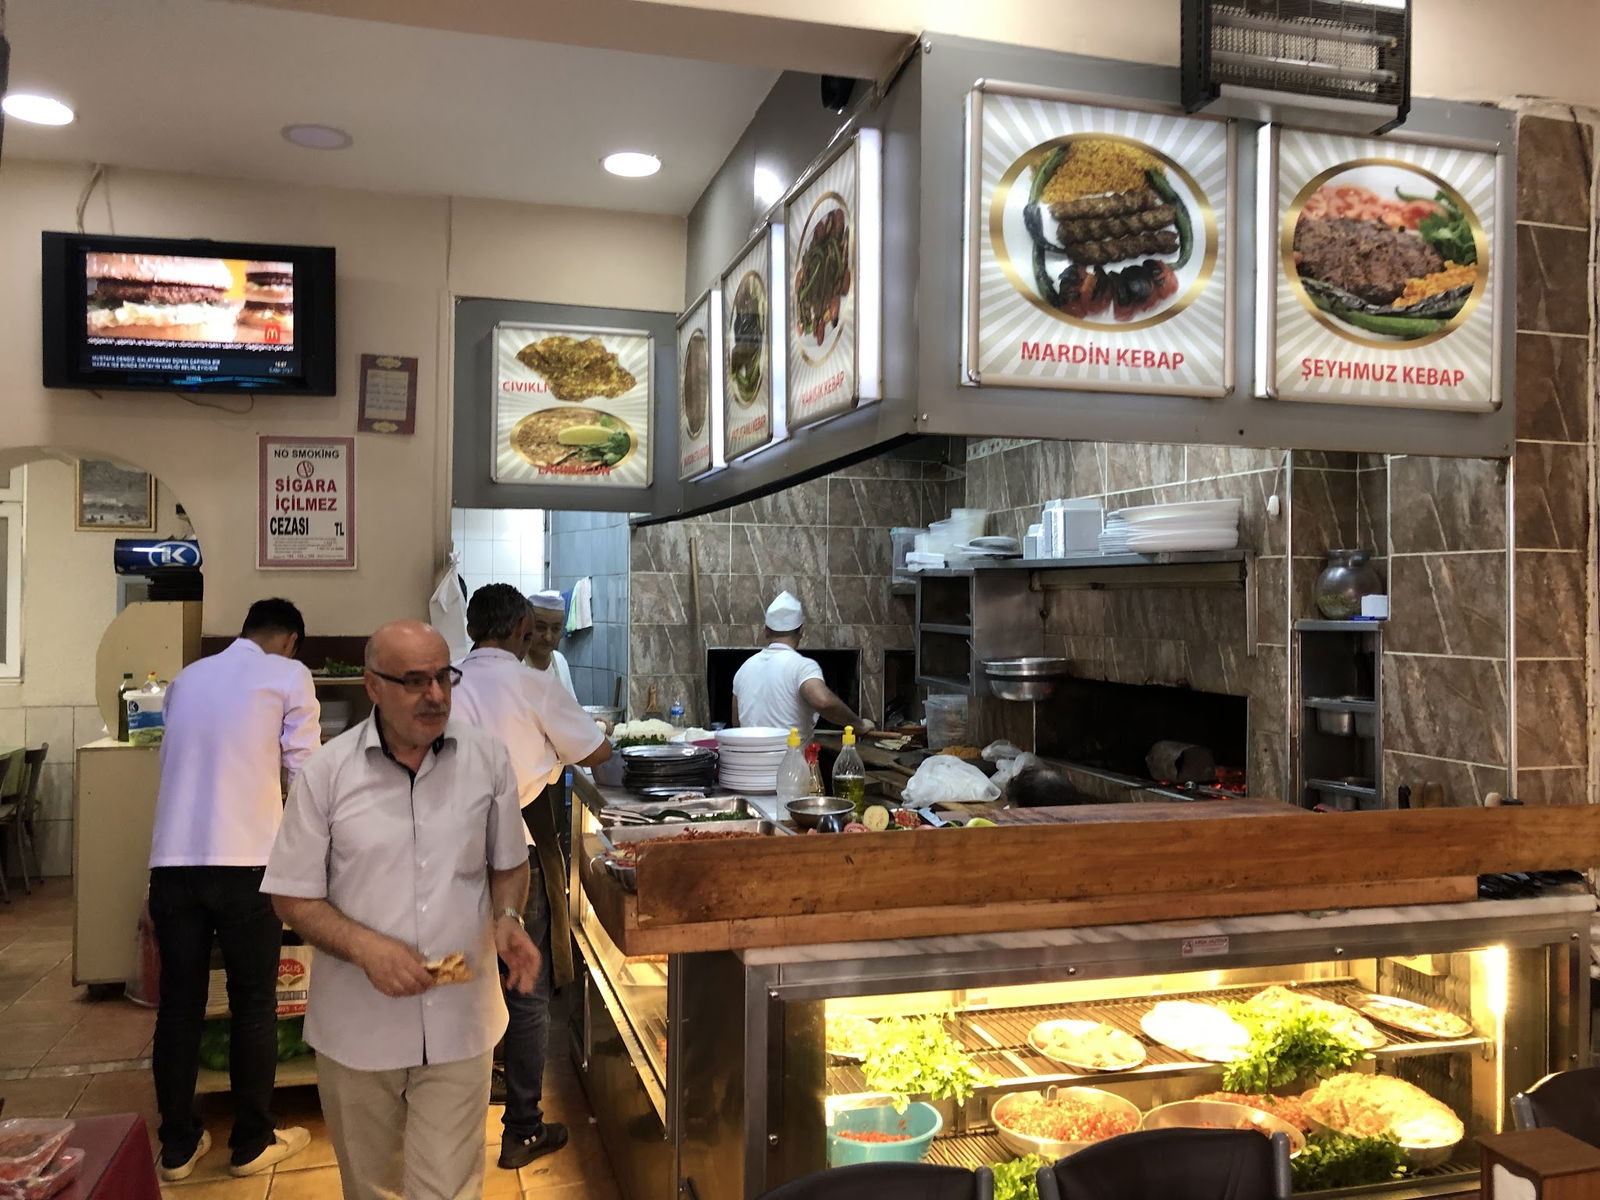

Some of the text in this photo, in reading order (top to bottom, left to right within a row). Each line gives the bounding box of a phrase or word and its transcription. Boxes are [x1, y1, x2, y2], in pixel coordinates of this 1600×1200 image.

[1021, 341, 1185, 370] MARDİN KEBAP
[1301, 357, 1465, 387] ŞEYHMUZ KEBAP
[274, 449, 289, 458] NO
[275, 475, 337, 493] SİGARA
[275, 494, 337, 514] İÇİLMEZ
[270, 516, 345, 536] CEZASI TL
